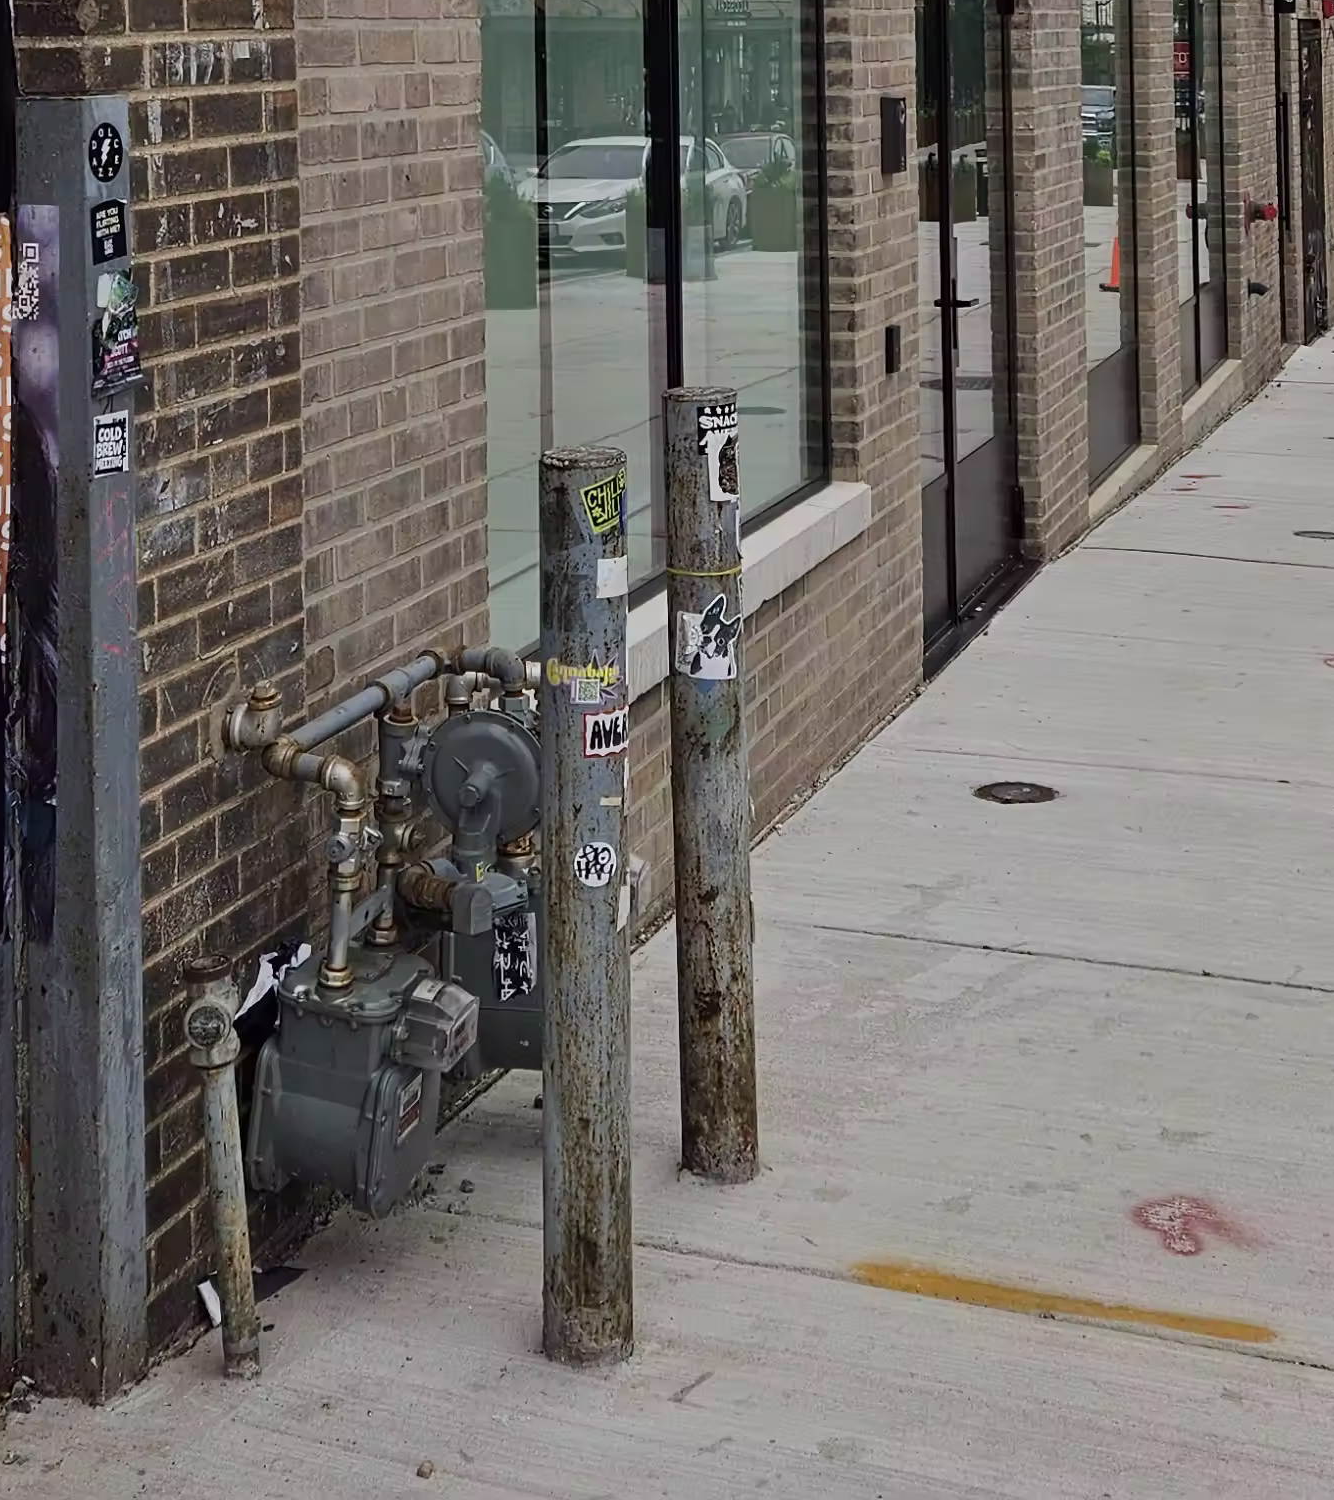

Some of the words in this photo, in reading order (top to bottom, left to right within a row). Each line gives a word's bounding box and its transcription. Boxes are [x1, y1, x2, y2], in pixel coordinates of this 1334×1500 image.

[96, 210, 106, 220] ARE
[107, 207, 118, 216] YOU
[98, 426, 122, 442] COLD
[96, 440, 123, 458] BREW
